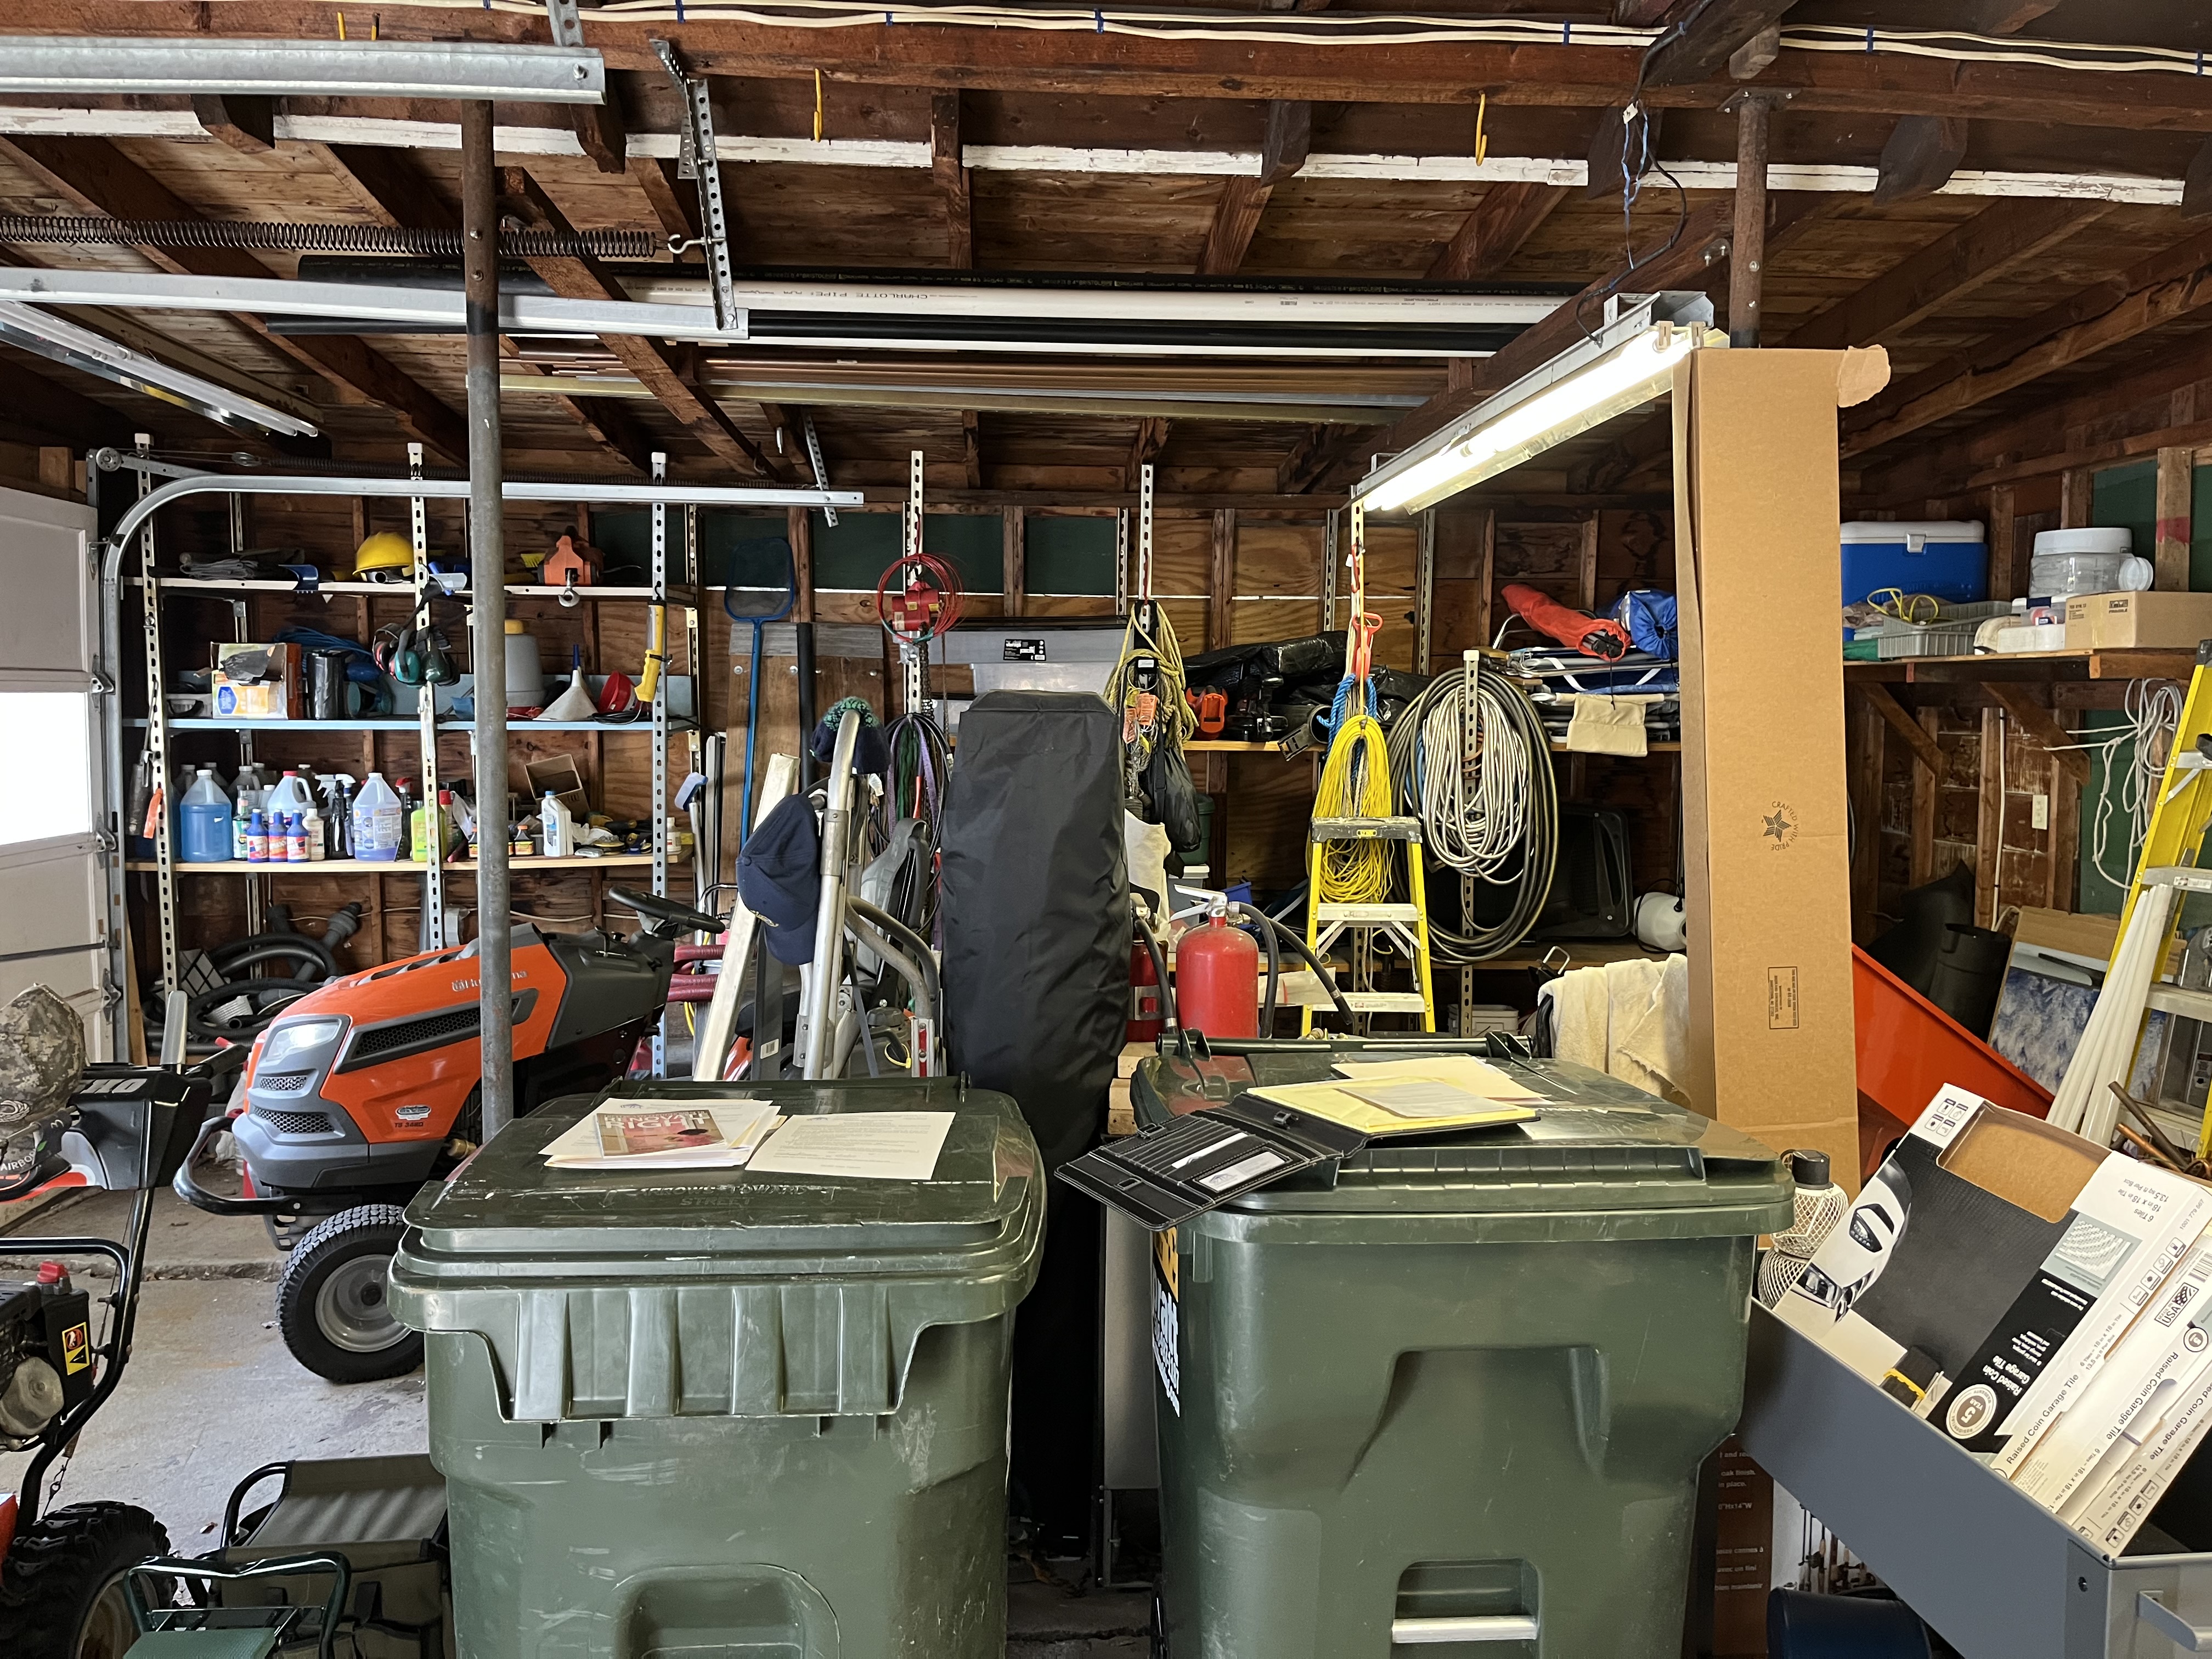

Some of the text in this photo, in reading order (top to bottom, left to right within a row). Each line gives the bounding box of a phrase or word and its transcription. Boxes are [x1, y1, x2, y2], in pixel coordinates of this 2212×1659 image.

[855, 291, 928, 300] CHARLOTTE
[1770, 801, 1799, 851] CRAFTED WITH PRIDE
[75, 1078, 147, 1093] HO
[604, 1112, 710, 1122] RENOVATE
[605, 1118, 706, 1130] RIGHT
[0, 1148, 36, 1171] AIRBOR
[636, 1183, 807, 1195] ARROWS TOWARD
[2134, 1183, 2144, 1191] Per
[680, 1197, 754, 1206] STREET
[2132, 1195, 2141, 1204] 18
[2154, 1192, 2169, 1203] 13.5
[2152, 1204, 2162, 1212] 18
[2134, 1209, 2148, 1220] Tiles
[2162, 1306, 2181, 1324] USA
[1993, 1355, 2030, 1385] Garage Tile
[2085, 1359, 2096, 1370] 13.5
[1982, 1364, 2023, 1396] Raised Coin
[2106, 1351, 2179, 1440] Raised Coin Garage Tile
[1970, 1398, 1983, 1411] YEAR
[1961, 1406, 1976, 1424] 5
[2006, 1436, 2030, 1464] Raised
[2028, 1418, 2045, 1436] Coin
[2042, 1389, 2067, 1417] Garage
[2064, 1374, 2079, 1389] Tile
[2149, 1397, 2204, 1460] Coin Garage Tile
